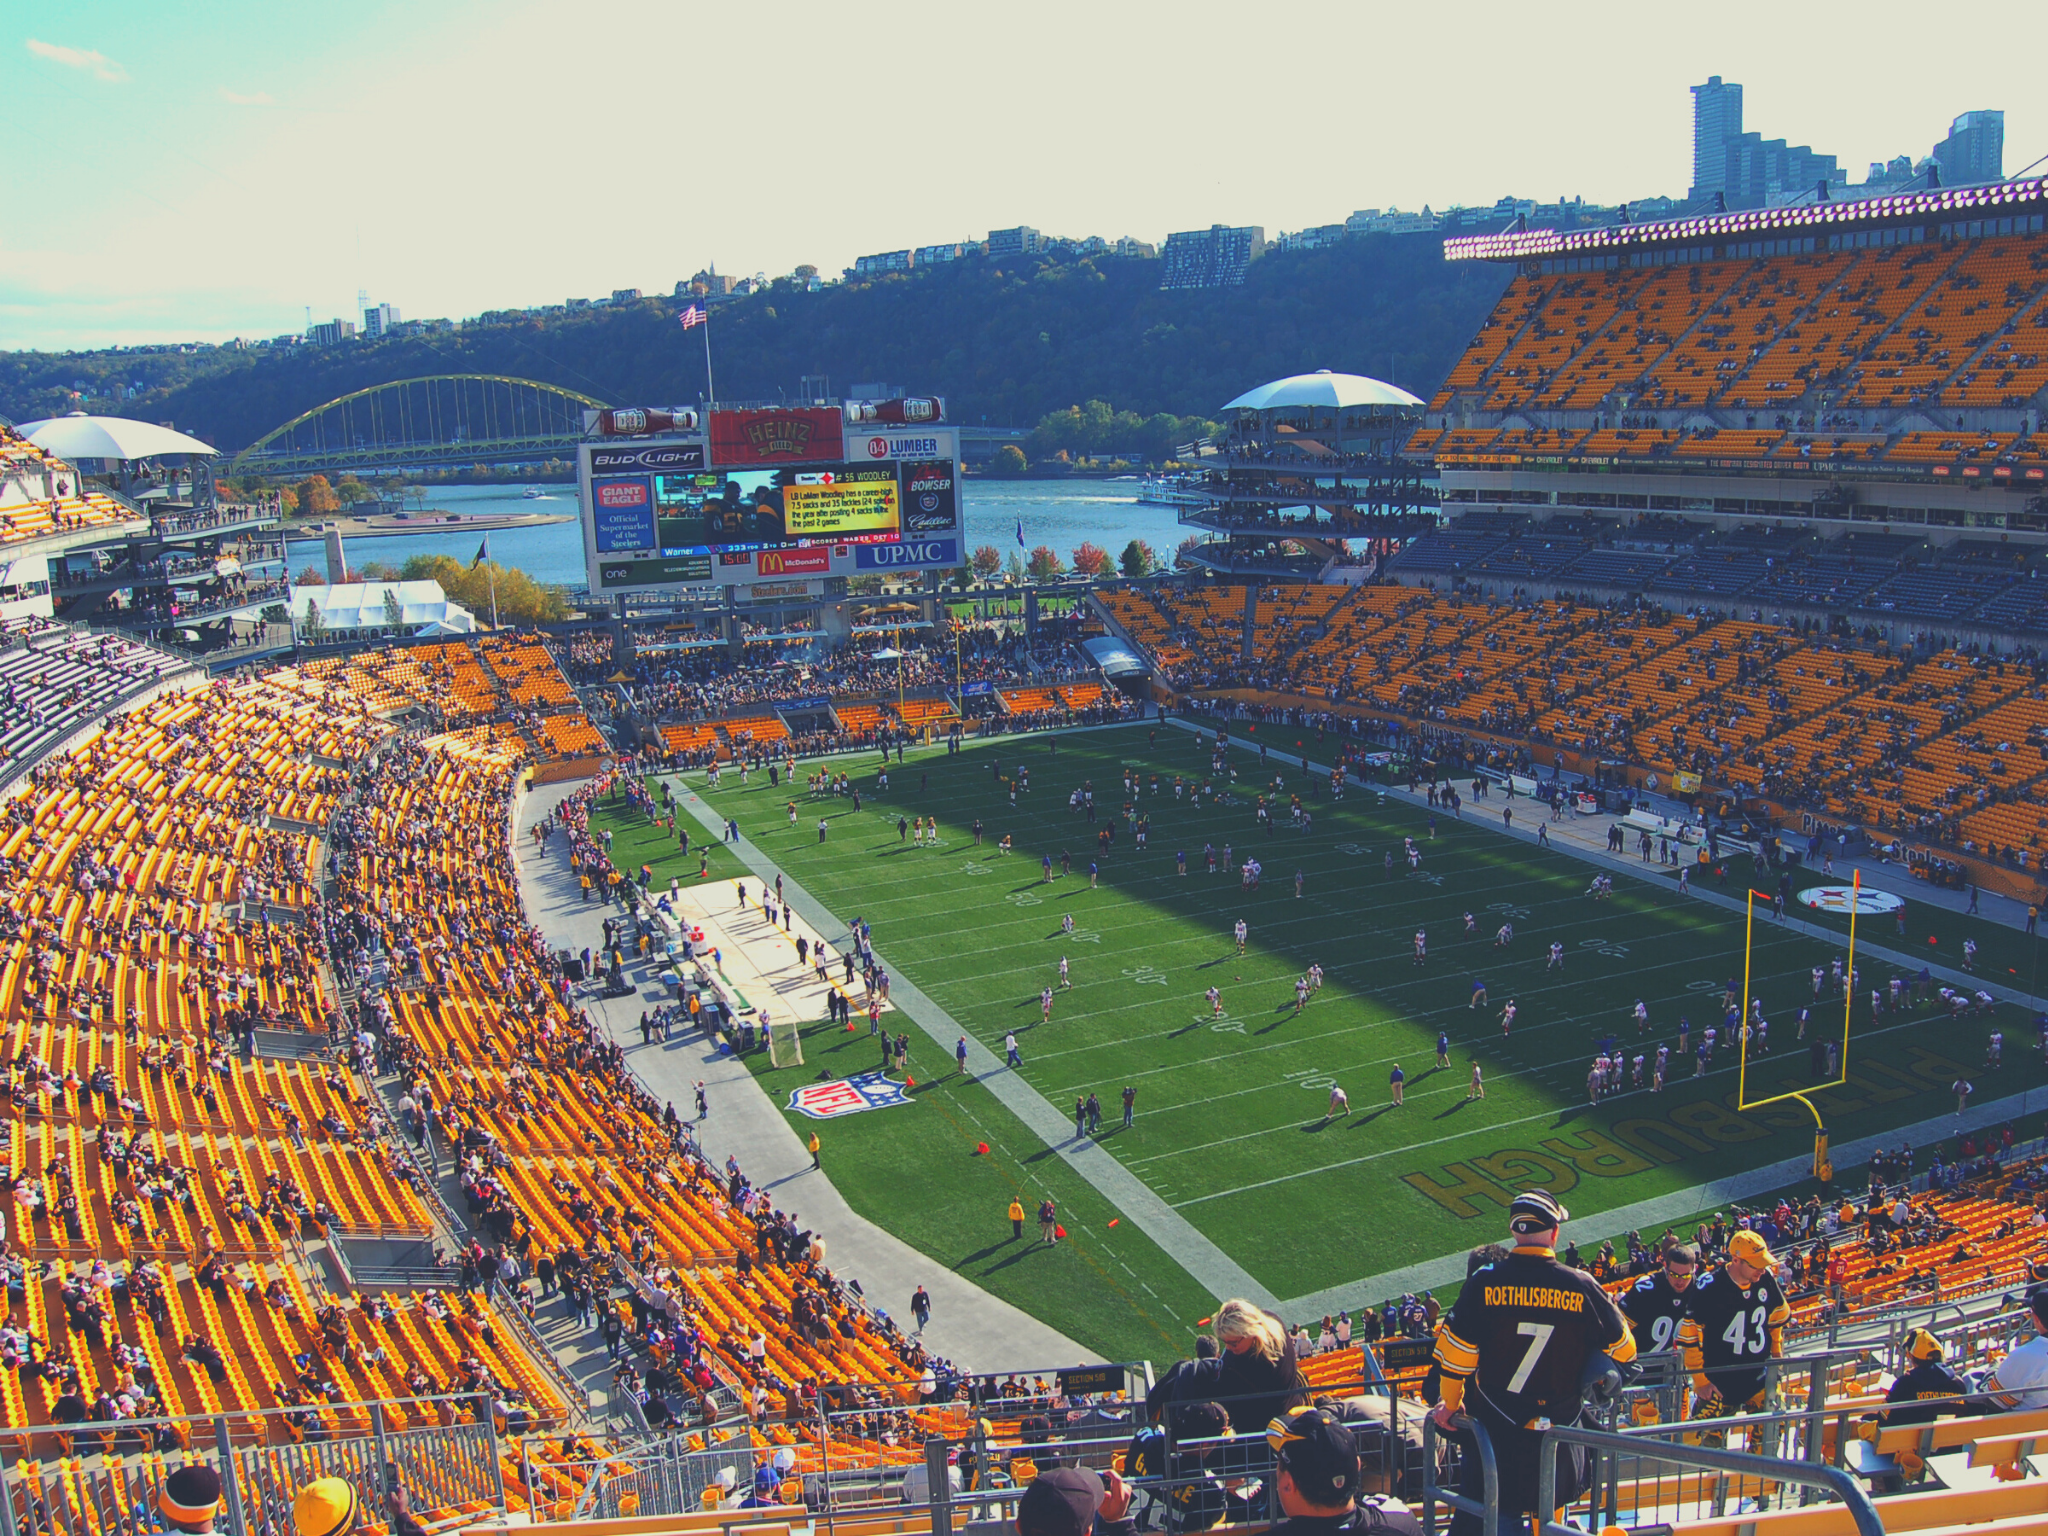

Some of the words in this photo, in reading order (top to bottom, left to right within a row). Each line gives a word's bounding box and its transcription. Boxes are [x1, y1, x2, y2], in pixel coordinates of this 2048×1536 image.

[748, 421, 810, 444] HEINZ
[771, 441, 792, 451] FIELD
[869, 441, 885, 455] 84
[889, 438, 937, 453] LUMBER
[595, 455, 636, 465] BUD
[645, 452, 700, 463] LIGHT
[1536, 456, 1563, 464] CHEVROLET
[1581, 457, 1609, 465] CHEVROLET
[1813, 462, 1837, 472] UPMC
[845, 472, 854, 482] 56
[857, 471, 891, 481] WOODLEY
[911, 479, 951, 492] BOWSER
[602, 486, 641, 497] GIANT
[819, 491, 845, 499] Woodley
[603, 495, 641, 505] EAGLE
[791, 501, 801, 509] 7.5
[802, 501, 819, 509] sacks
[820, 500, 831, 508] and
[832, 499, 840, 507] 35
[830, 508, 850, 517] posting
[851, 507, 855, 515] 4
[856, 506, 873, 514] sacks
[609, 514, 639, 523] Official
[816, 518, 821, 526] 2
[821, 518, 840, 527] games
[908, 513, 952, 528] Cadillac
[599, 522, 649, 533] Supermarket
[615, 531, 623, 539] of
[611, 539, 641, 548] Steelers
[664, 547, 694, 557] Warner
[871, 542, 942, 565] UPMC
[724, 553, 749, 565] 15:00
[784, 558, 825, 567] McDonald's
[606, 569, 627, 579] one
[751, 584, 808, 598] Steelers.com
[803, 1082, 863, 1114] NFL
[1400, 1046, 1986, 1219] PITTSBURGH
[1484, 1286, 1584, 1313] ROETHLISBERGER
[1722, 1306, 1767, 1355] 43
[1391, 1347, 1415, 1358] SECTION
[1506, 1322, 1555, 1394] 7
[1068, 1374, 1094, 1384] SECTION
[1916, 1391, 1965, 1405] ROETHLIS
